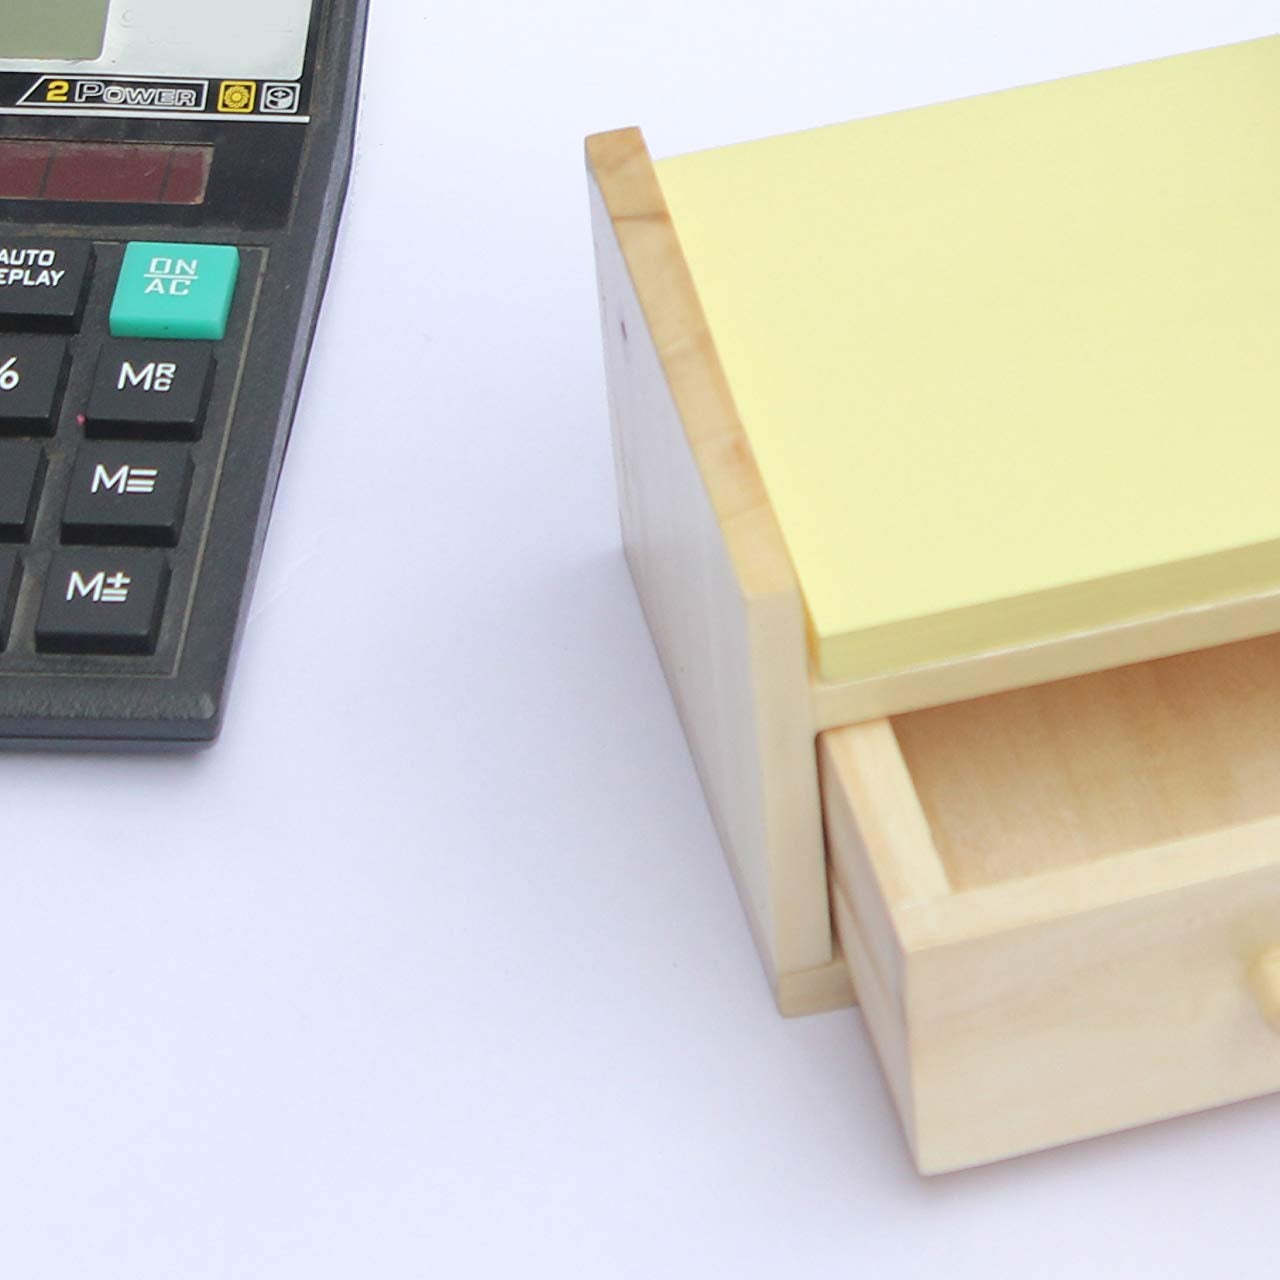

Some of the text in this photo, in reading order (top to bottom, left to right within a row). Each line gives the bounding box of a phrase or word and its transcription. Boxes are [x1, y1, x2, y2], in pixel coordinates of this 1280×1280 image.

[46, 80, 70, 102] 2
[0, 248, 56, 267] AUTO
[149, 257, 197, 274] ON
[0, 268, 65, 287] EPLAY
[144, 278, 191, 295] AC
